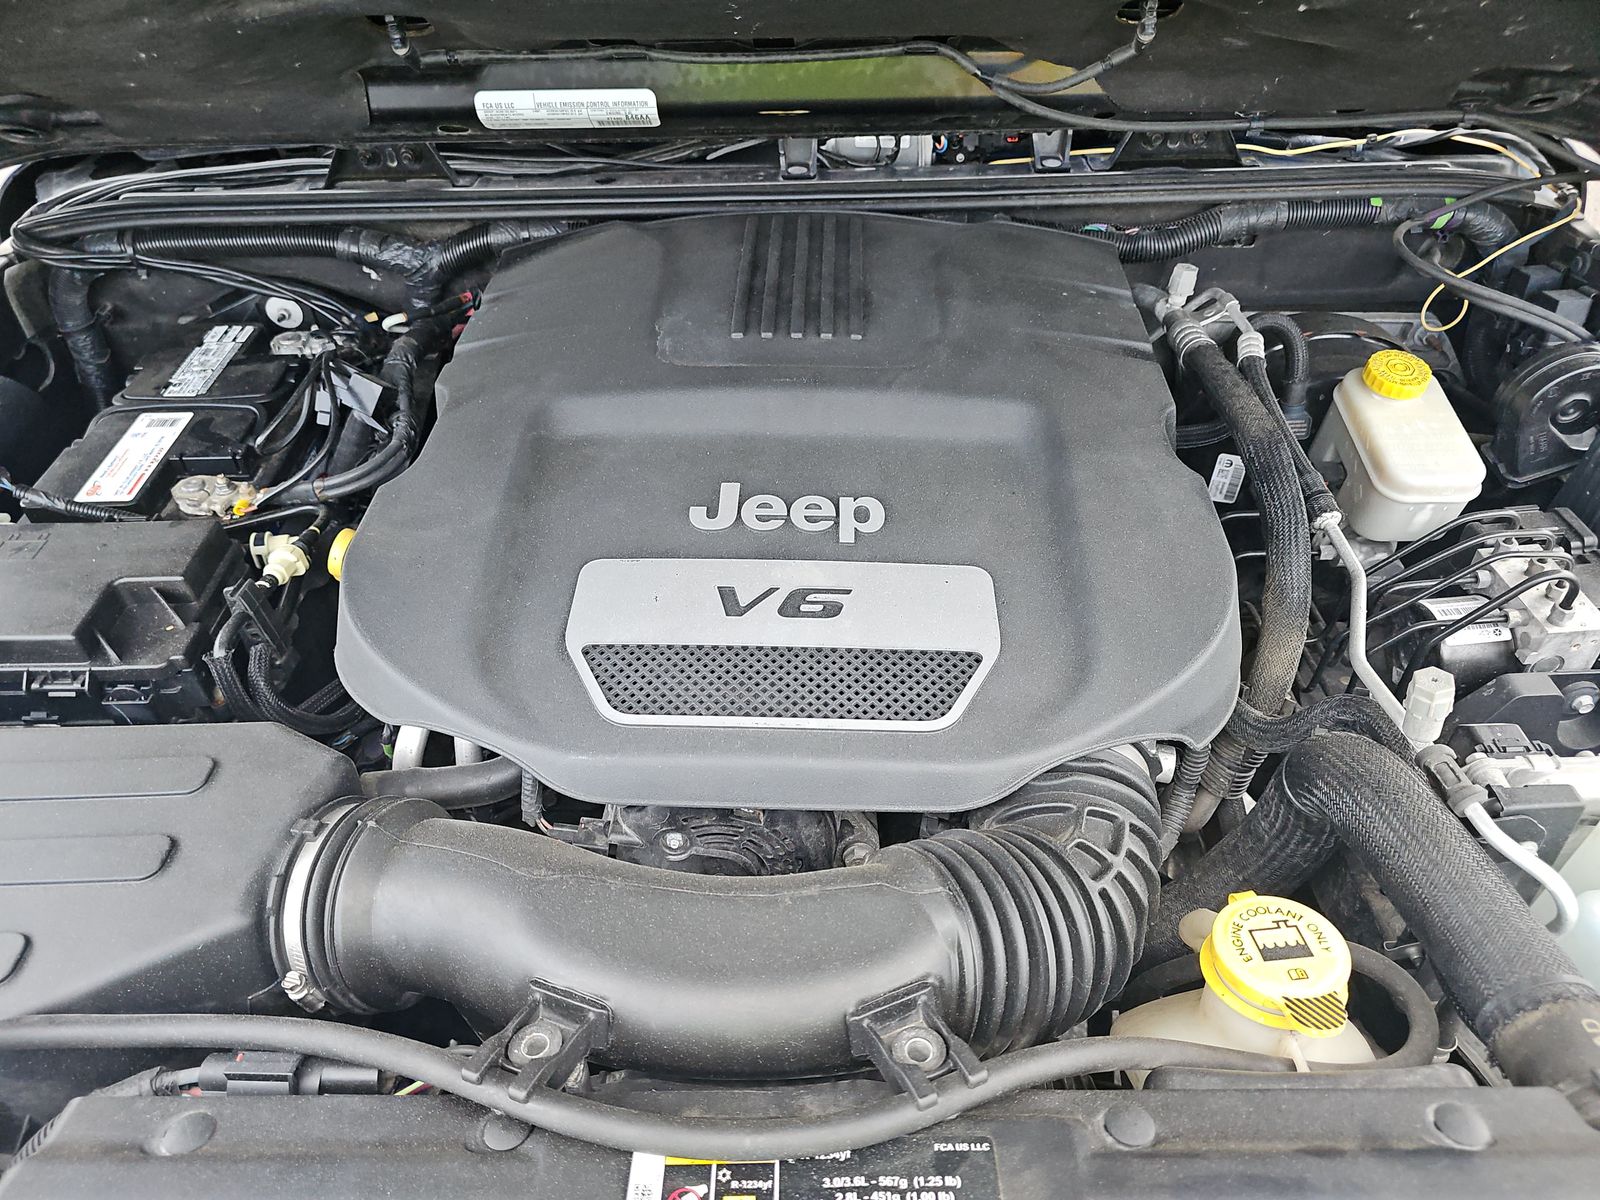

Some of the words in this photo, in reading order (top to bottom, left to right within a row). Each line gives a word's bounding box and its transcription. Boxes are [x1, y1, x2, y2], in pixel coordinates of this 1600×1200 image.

[536, 101, 558, 109] VEHICLE
[586, 100, 610, 108] CONTROL
[689, 482, 885, 543] Jeep
[716, 585, 853, 619] V6
[1239, 906, 1304, 922] COOLANT
[1231, 920, 1253, 963] ENGINE
[1306, 923, 1332, 953] ONLY
[933, 1142, 955, 1151] FCA
[955, 1142, 970, 1151] US
[970, 1142, 991, 1151] LLC
[878, 1175, 909, 1190] 567g
[913, 1175, 944, 1189] (1.25
[944, 1175, 962, 1189] lb)
[834, 1192, 861, 1200] 28L
